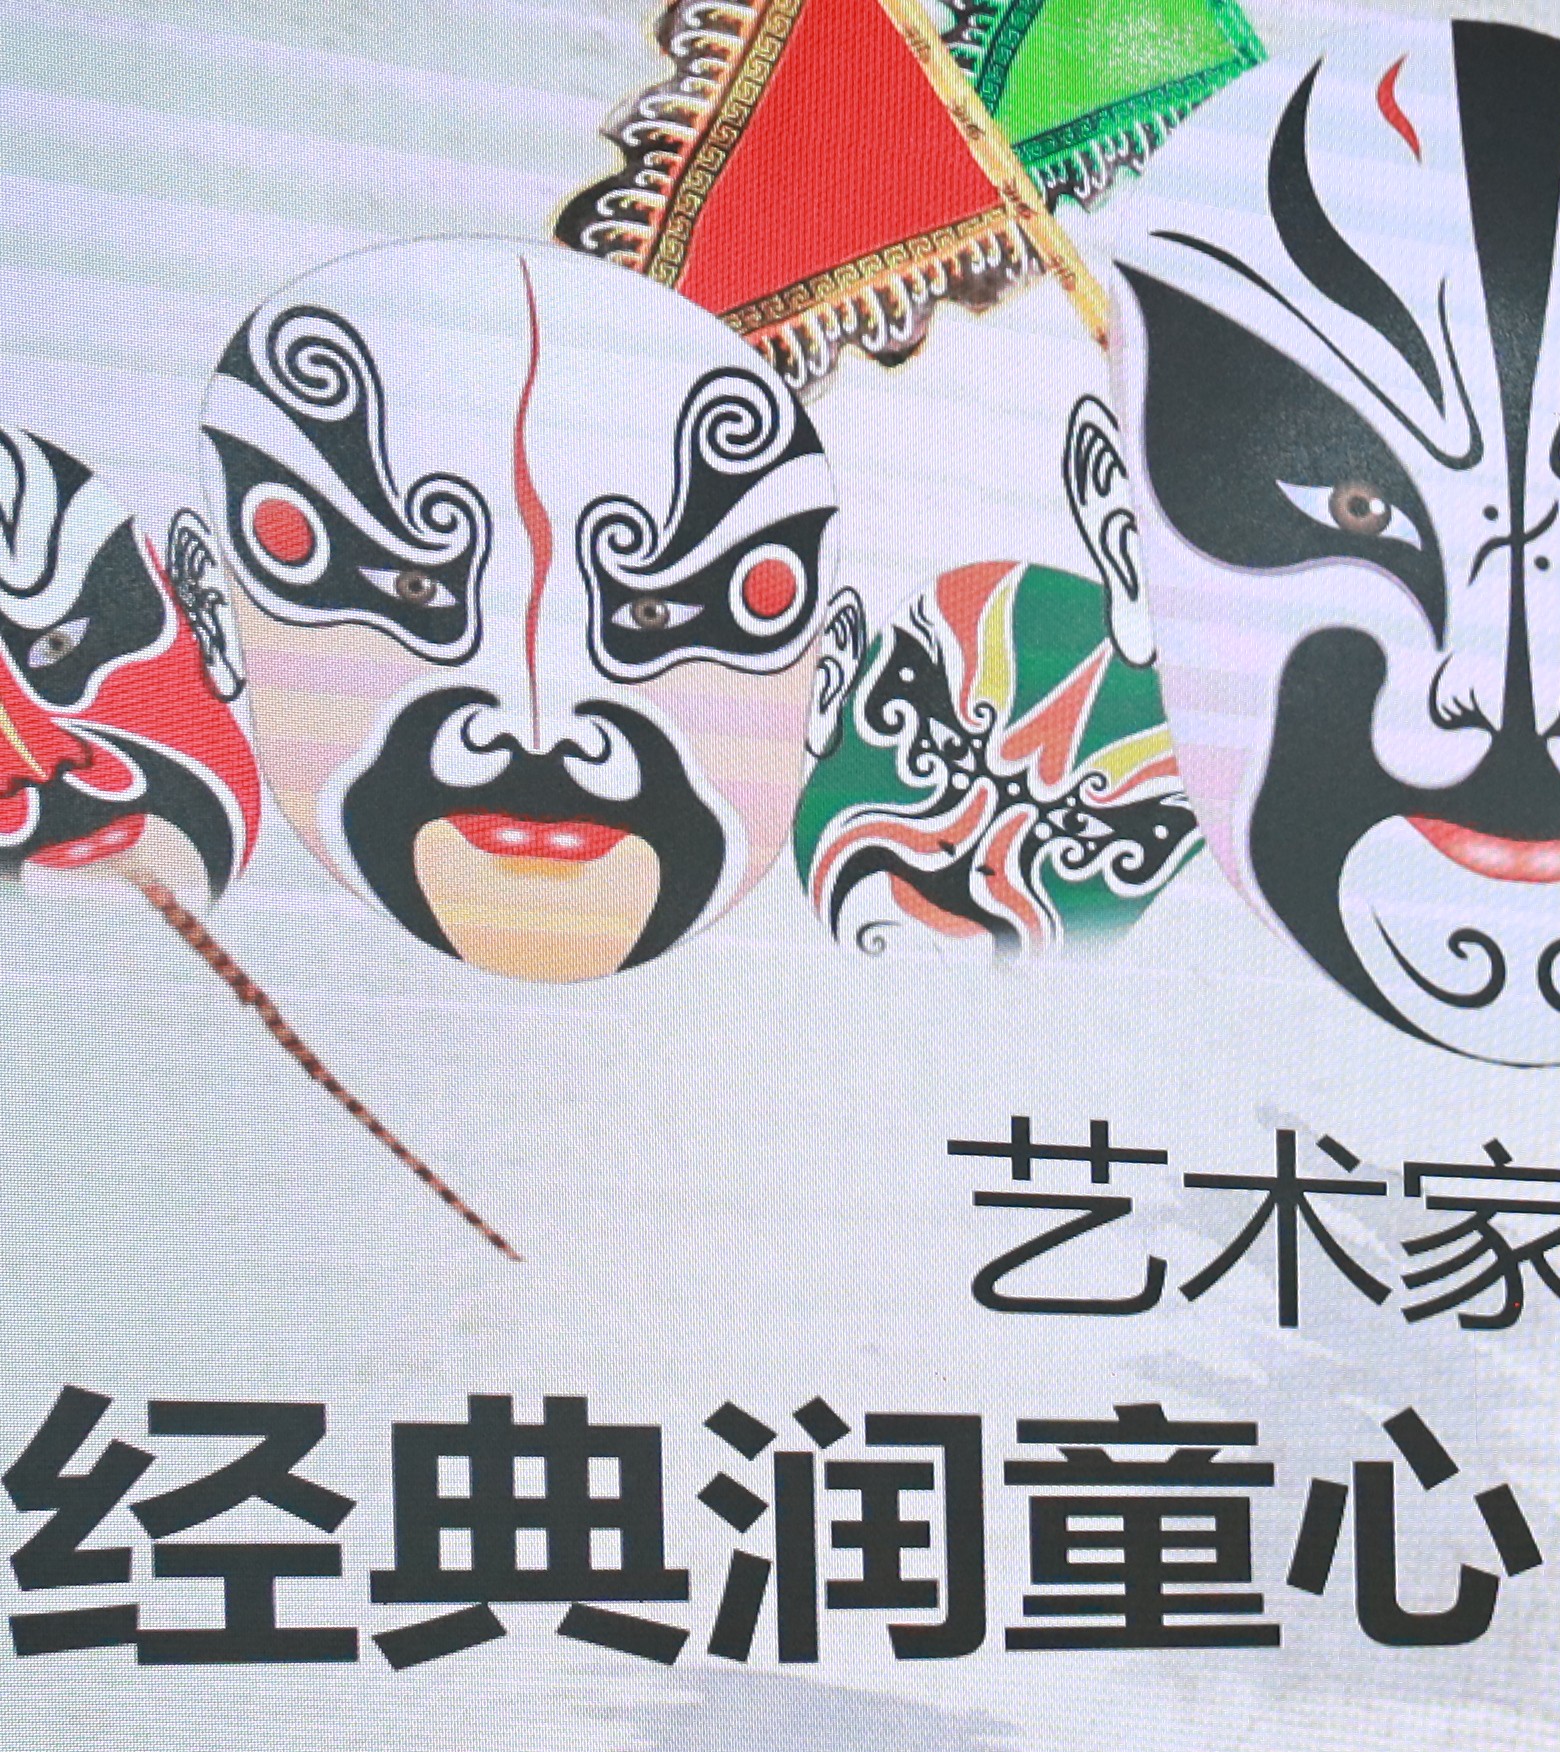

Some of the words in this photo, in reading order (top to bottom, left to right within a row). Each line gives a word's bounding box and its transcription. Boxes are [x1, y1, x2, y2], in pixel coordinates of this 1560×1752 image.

[0, 1384, 1543, 1671] 经典润童心
